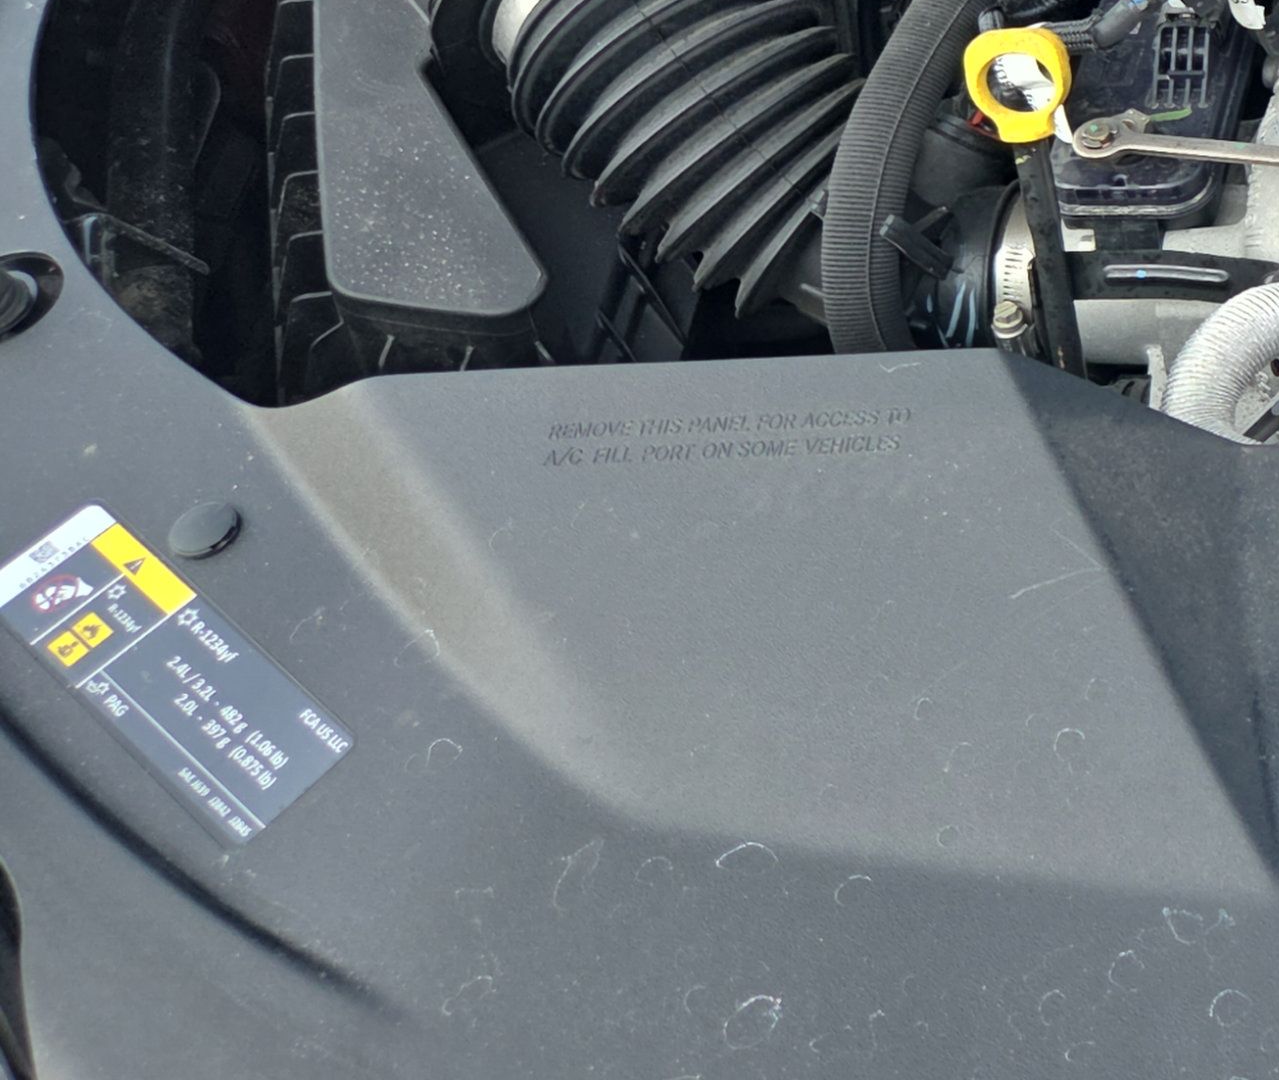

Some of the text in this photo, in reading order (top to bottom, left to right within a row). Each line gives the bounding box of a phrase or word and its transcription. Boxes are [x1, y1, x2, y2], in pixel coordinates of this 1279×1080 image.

[549, 407, 912, 439] REMOVE THIS PANEL FOR ACCESS TO
[542, 434, 901, 466] A/C FILL PORT ON SOME VEHICLES
[190, 620, 240, 664] R-1234yf
[103, 692, 129, 719] PAG
[173, 692, 200, 717] 2.0L
[299, 708, 349, 754] FCA US LLC
